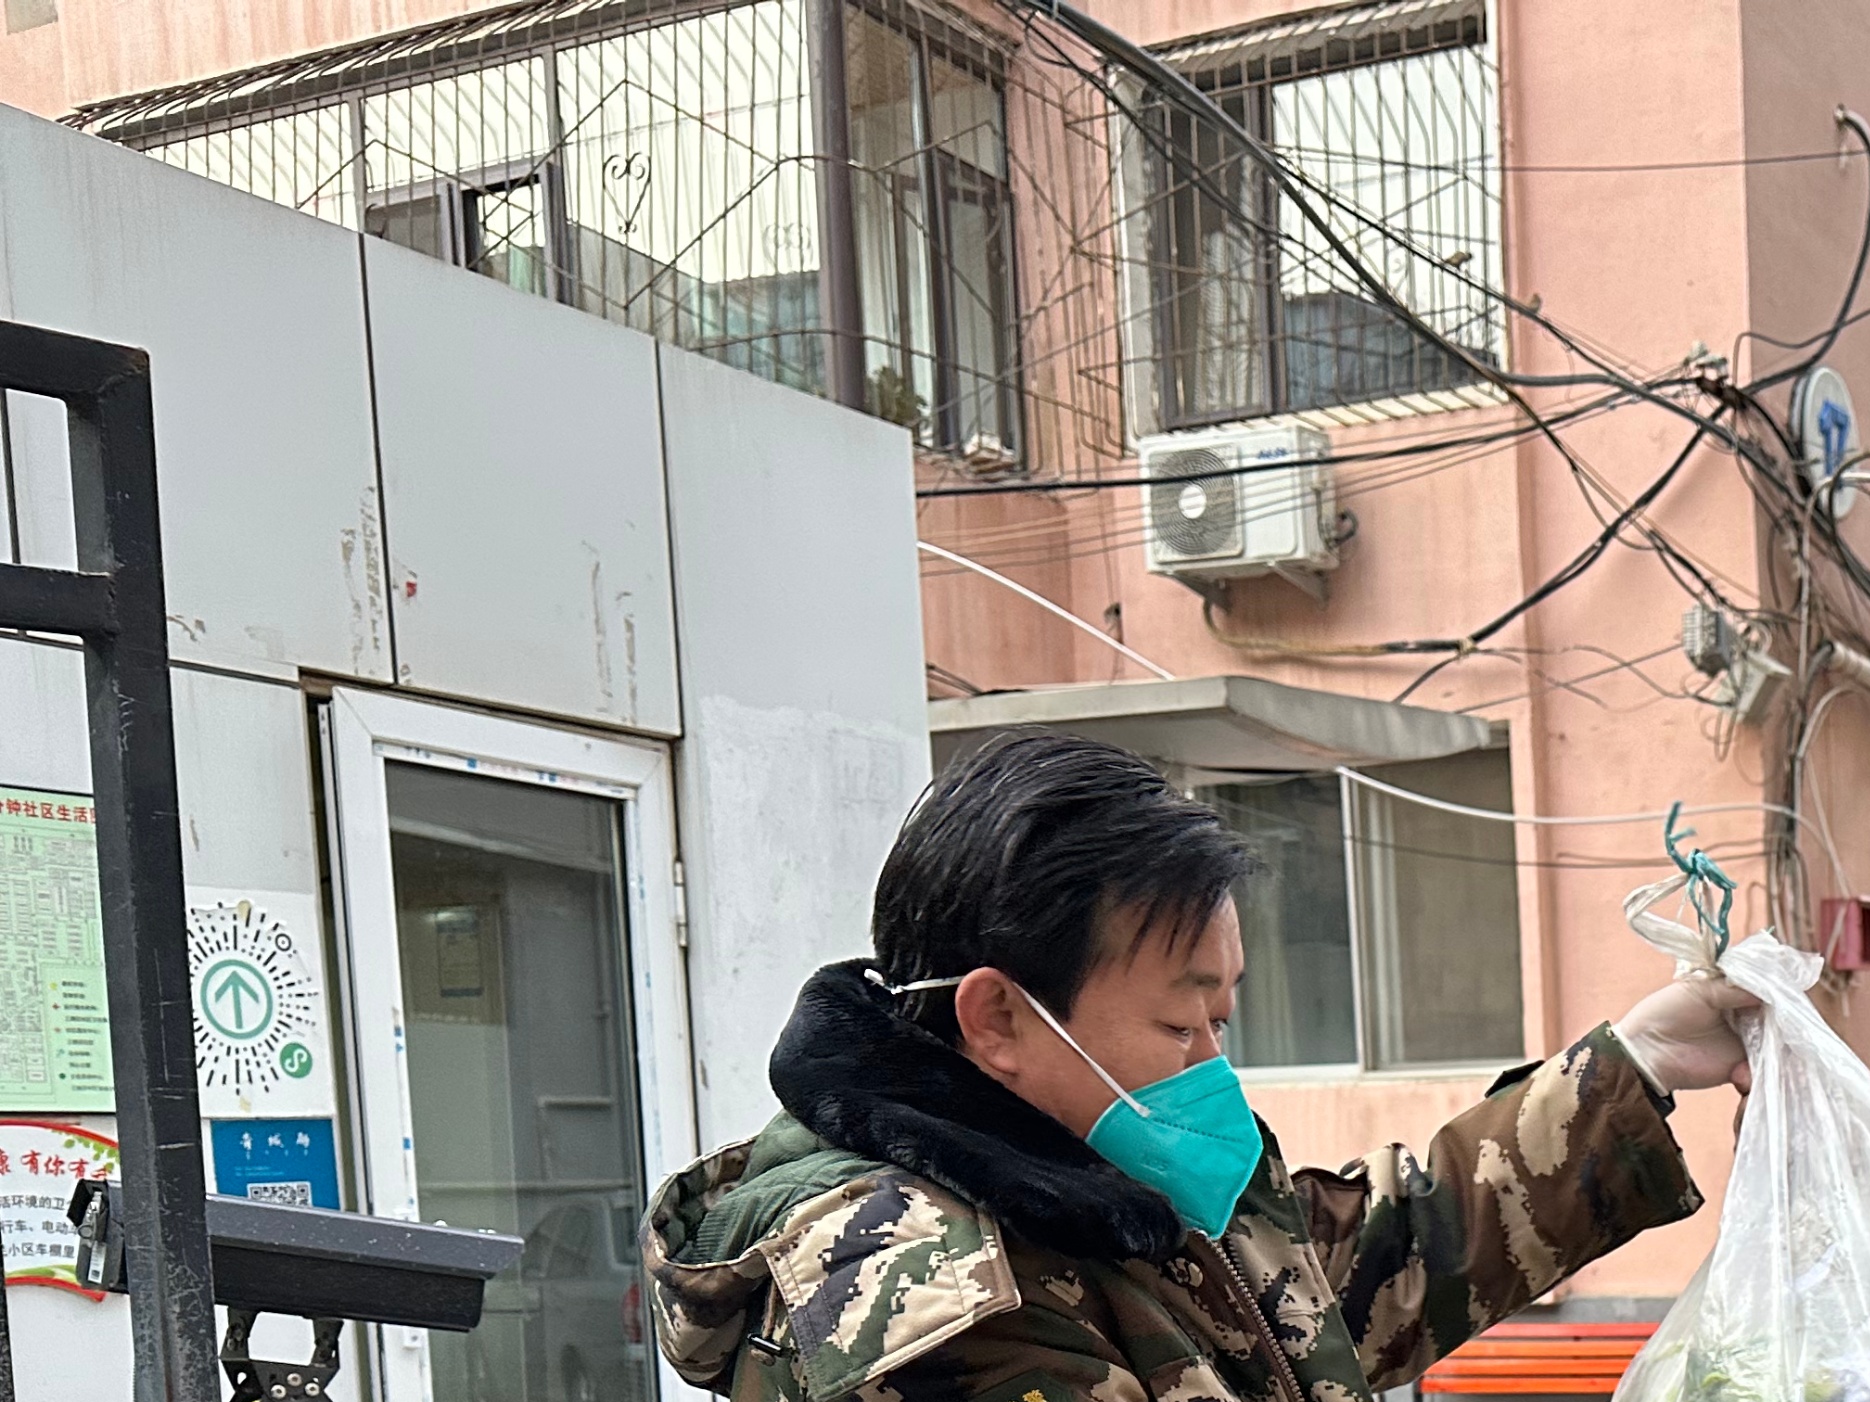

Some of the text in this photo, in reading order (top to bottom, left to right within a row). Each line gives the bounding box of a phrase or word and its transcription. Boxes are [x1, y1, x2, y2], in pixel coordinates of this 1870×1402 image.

[0, 798, 96, 824] 钟社区生活
[0, 1194, 72, 1211] 活环境的卫
